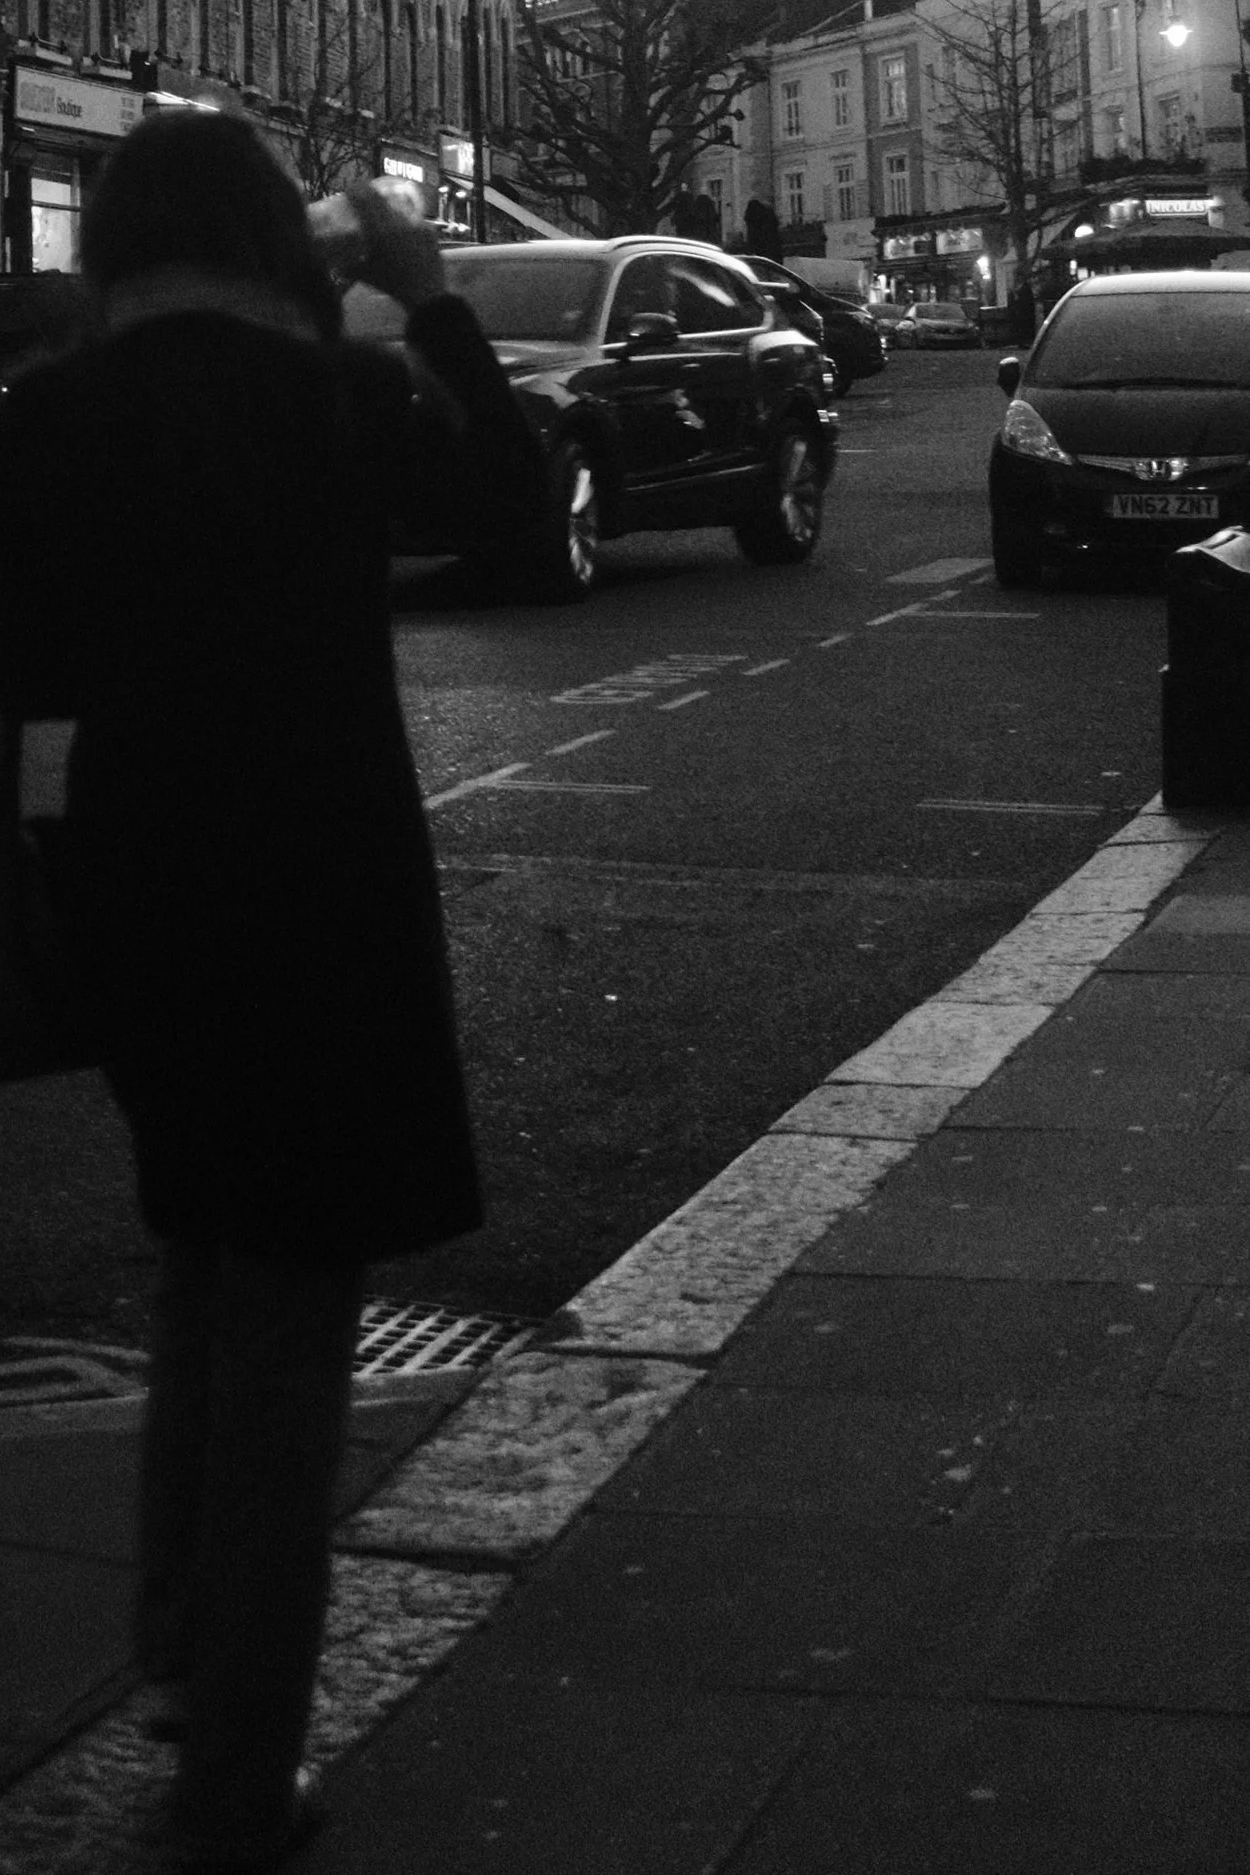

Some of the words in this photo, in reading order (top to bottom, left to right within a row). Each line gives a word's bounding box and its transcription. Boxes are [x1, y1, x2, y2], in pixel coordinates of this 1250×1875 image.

[1150, 201, 1206, 213] NICOLAS
[1118, 496, 1170, 515] VN62
[1175, 496, 1215, 515] ZNT
